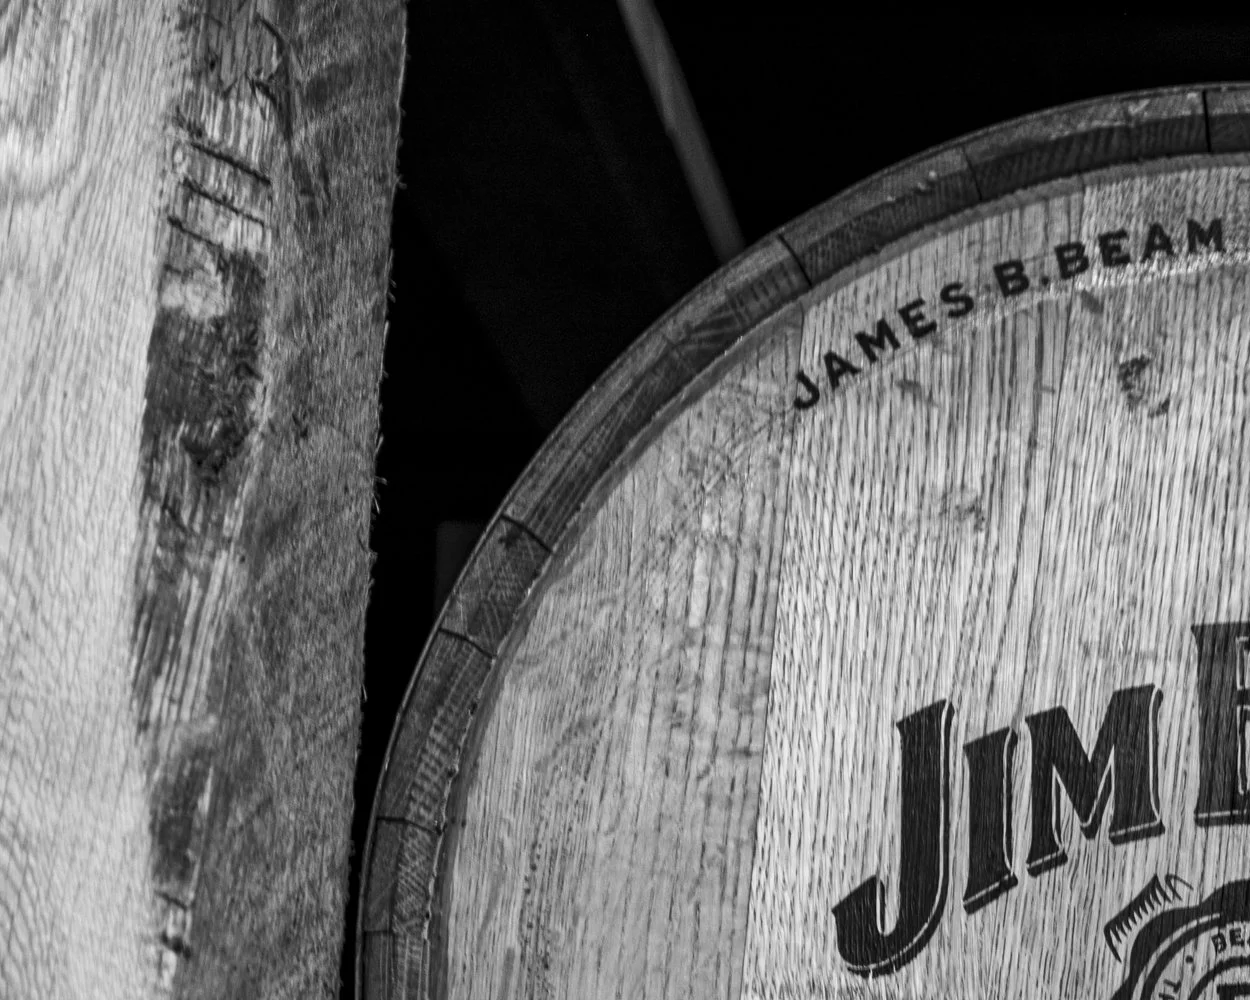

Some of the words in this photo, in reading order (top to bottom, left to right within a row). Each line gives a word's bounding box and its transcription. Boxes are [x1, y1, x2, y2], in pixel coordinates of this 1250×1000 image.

[793, 282, 974, 410] JAMES
[1054, 218, 1224, 279] BEAM
[832, 684, 1165, 975] JIM
